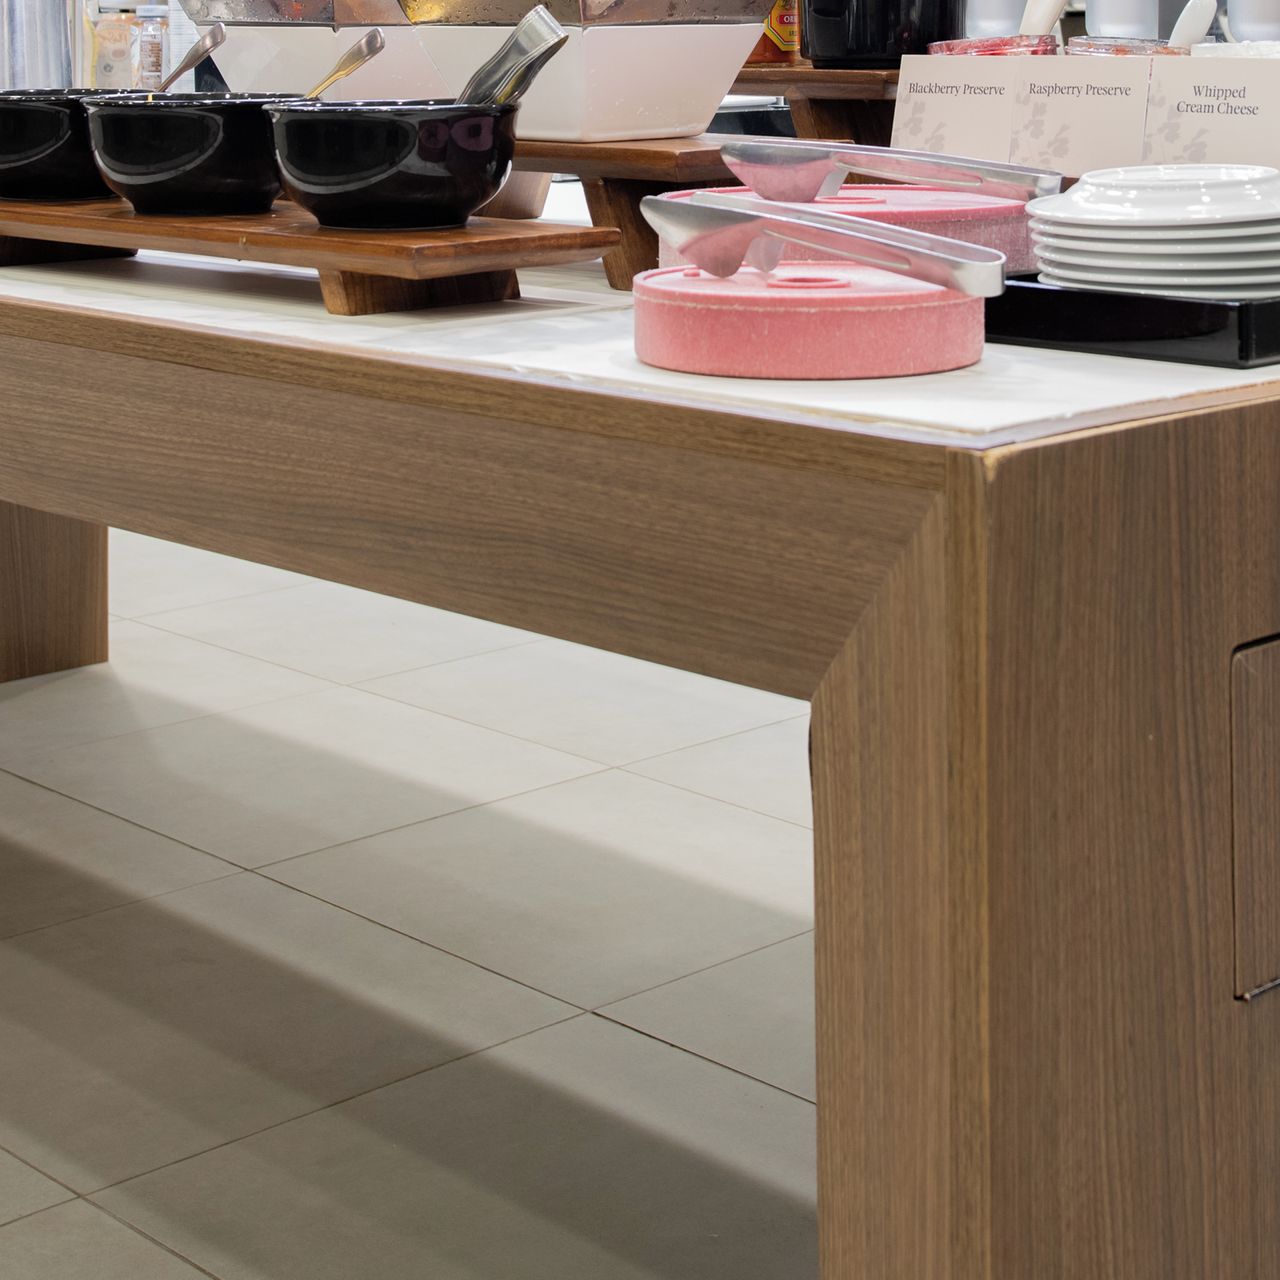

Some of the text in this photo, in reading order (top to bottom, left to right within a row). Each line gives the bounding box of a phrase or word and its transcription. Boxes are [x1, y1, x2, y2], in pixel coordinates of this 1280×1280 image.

[908, 82, 1005, 96] Blackberry Preserve
[1029, 83, 1132, 97] Raspberry Preserve
[1193, 85, 1247, 100] Whipped
[1176, 101, 1259, 116] Cream Cheese
